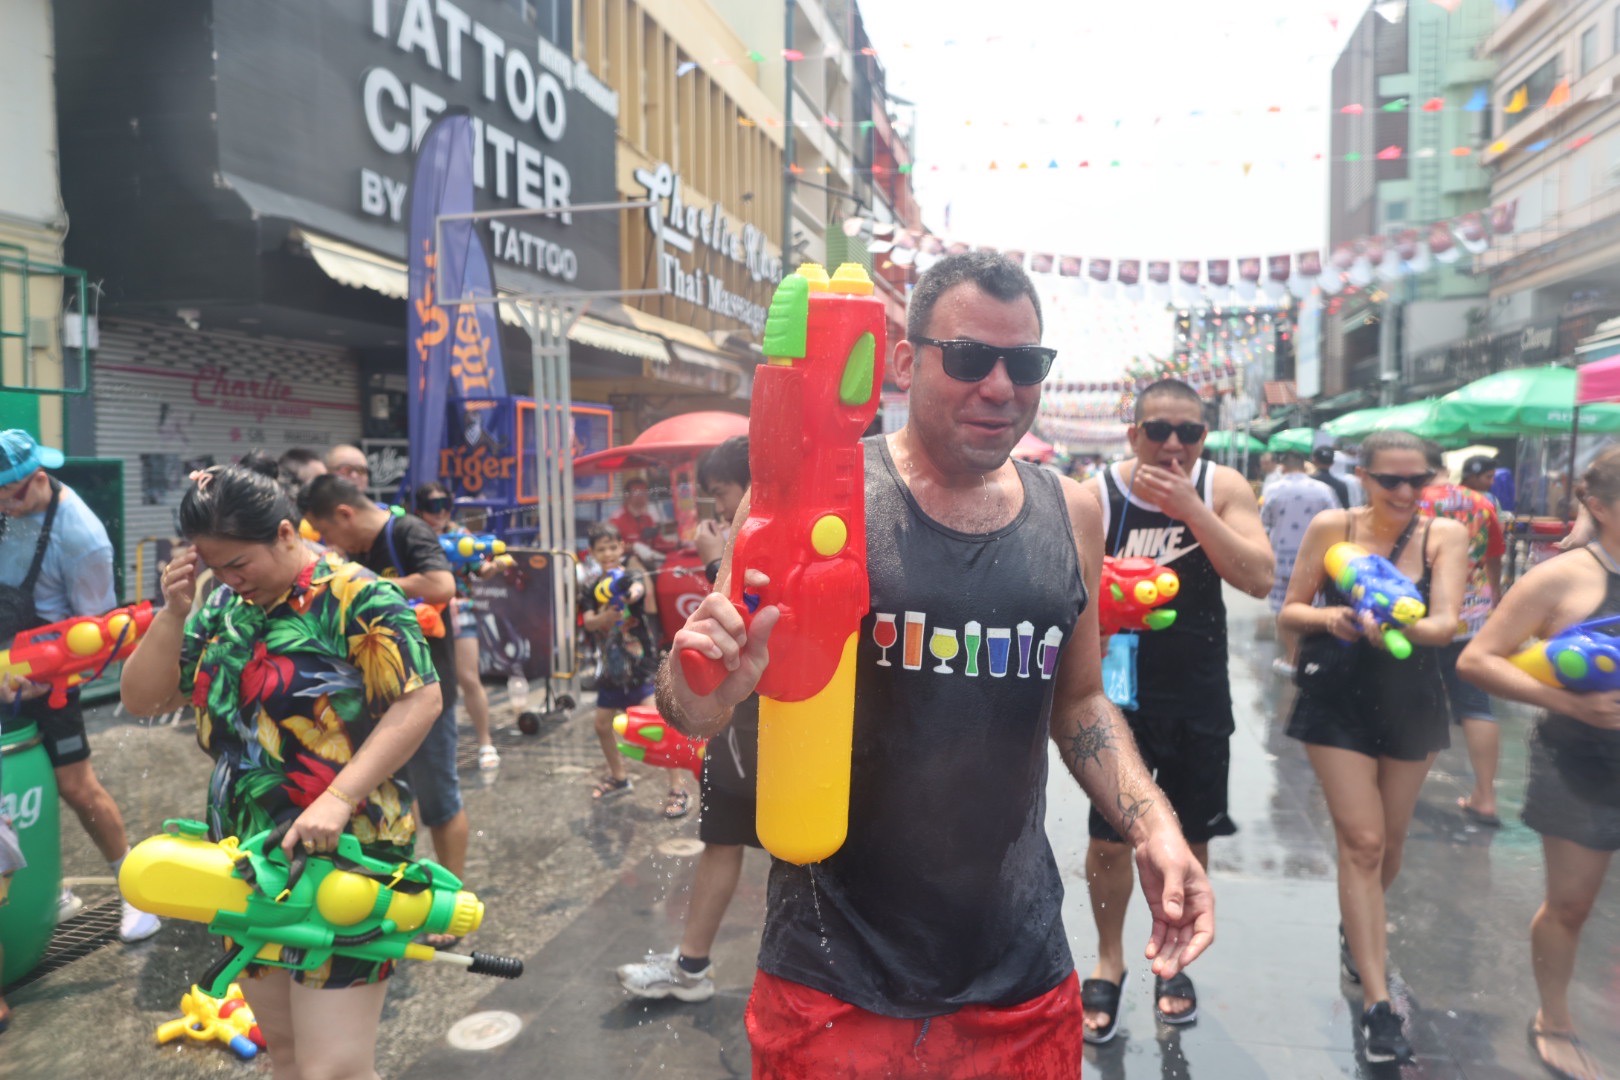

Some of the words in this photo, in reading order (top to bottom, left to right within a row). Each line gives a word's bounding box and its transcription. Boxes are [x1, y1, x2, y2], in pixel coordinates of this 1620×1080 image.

[361, 167, 408, 223] BY
[489, 219, 578, 282] TATTOO
[663, 252, 704, 306] Thai
[438, 446, 516, 492] Tiger
[1123, 526, 1186, 559] NIKE
